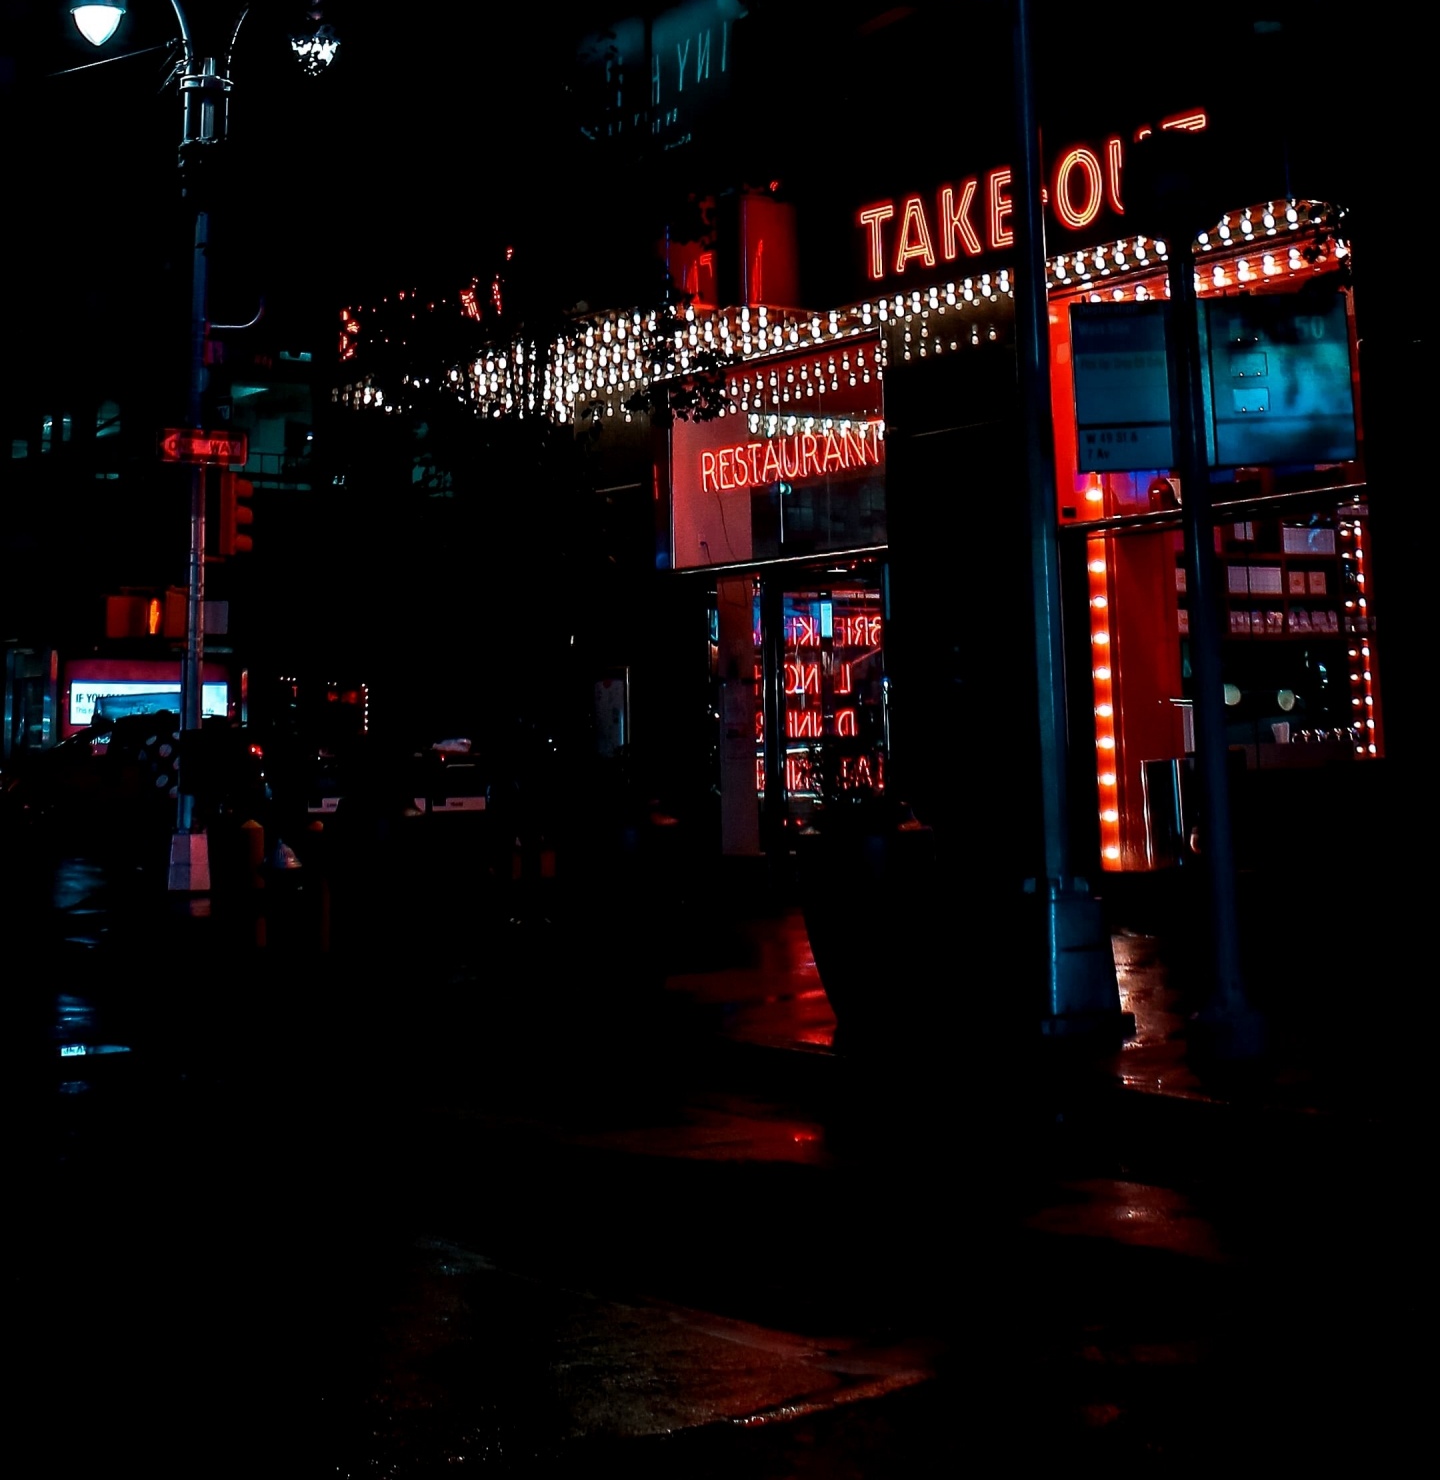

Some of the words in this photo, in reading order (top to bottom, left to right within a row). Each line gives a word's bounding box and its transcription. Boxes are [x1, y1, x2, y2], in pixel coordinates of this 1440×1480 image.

[209, 439, 240, 456] WAY
[701, 418, 886, 493] RESTAURANT
[75, 693, 84, 703] IF
